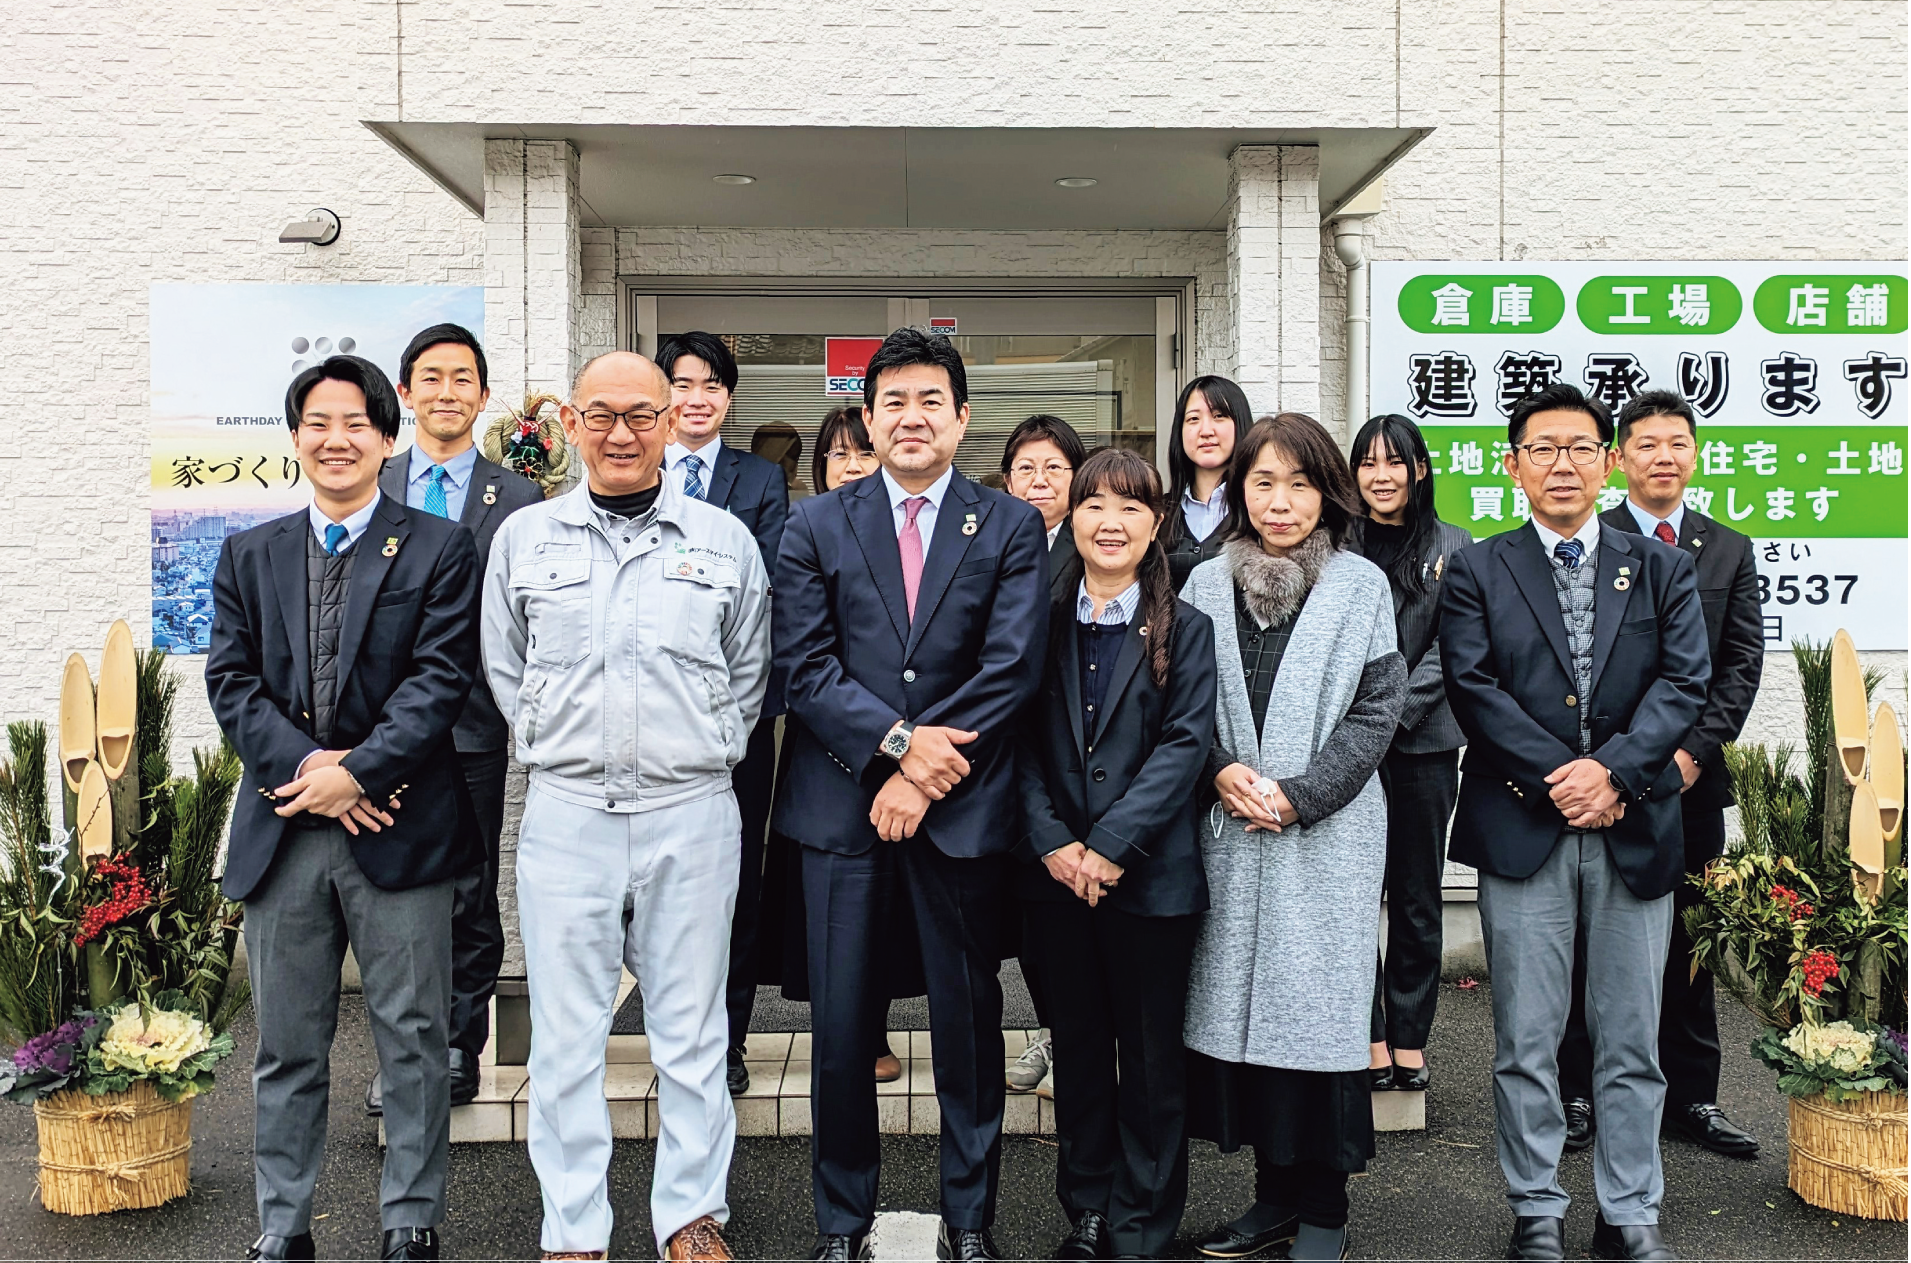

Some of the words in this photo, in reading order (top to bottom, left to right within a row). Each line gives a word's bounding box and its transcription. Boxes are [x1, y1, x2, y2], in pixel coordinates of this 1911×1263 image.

[1430, 282, 1534, 326] 倉庫
[1608, 283, 1711, 326] 工場
[1785, 283, 1890, 327] 店舗
[829, 378, 865, 391] SECO
[1407, 350, 1907, 419] 建築承ります
[216, 416, 283, 425] EARTHDAY
[172, 455, 300, 489] 家づくり
[1700, 440, 1904, 476] 住宅・土地
[1752, 541, 1812, 562] さい
